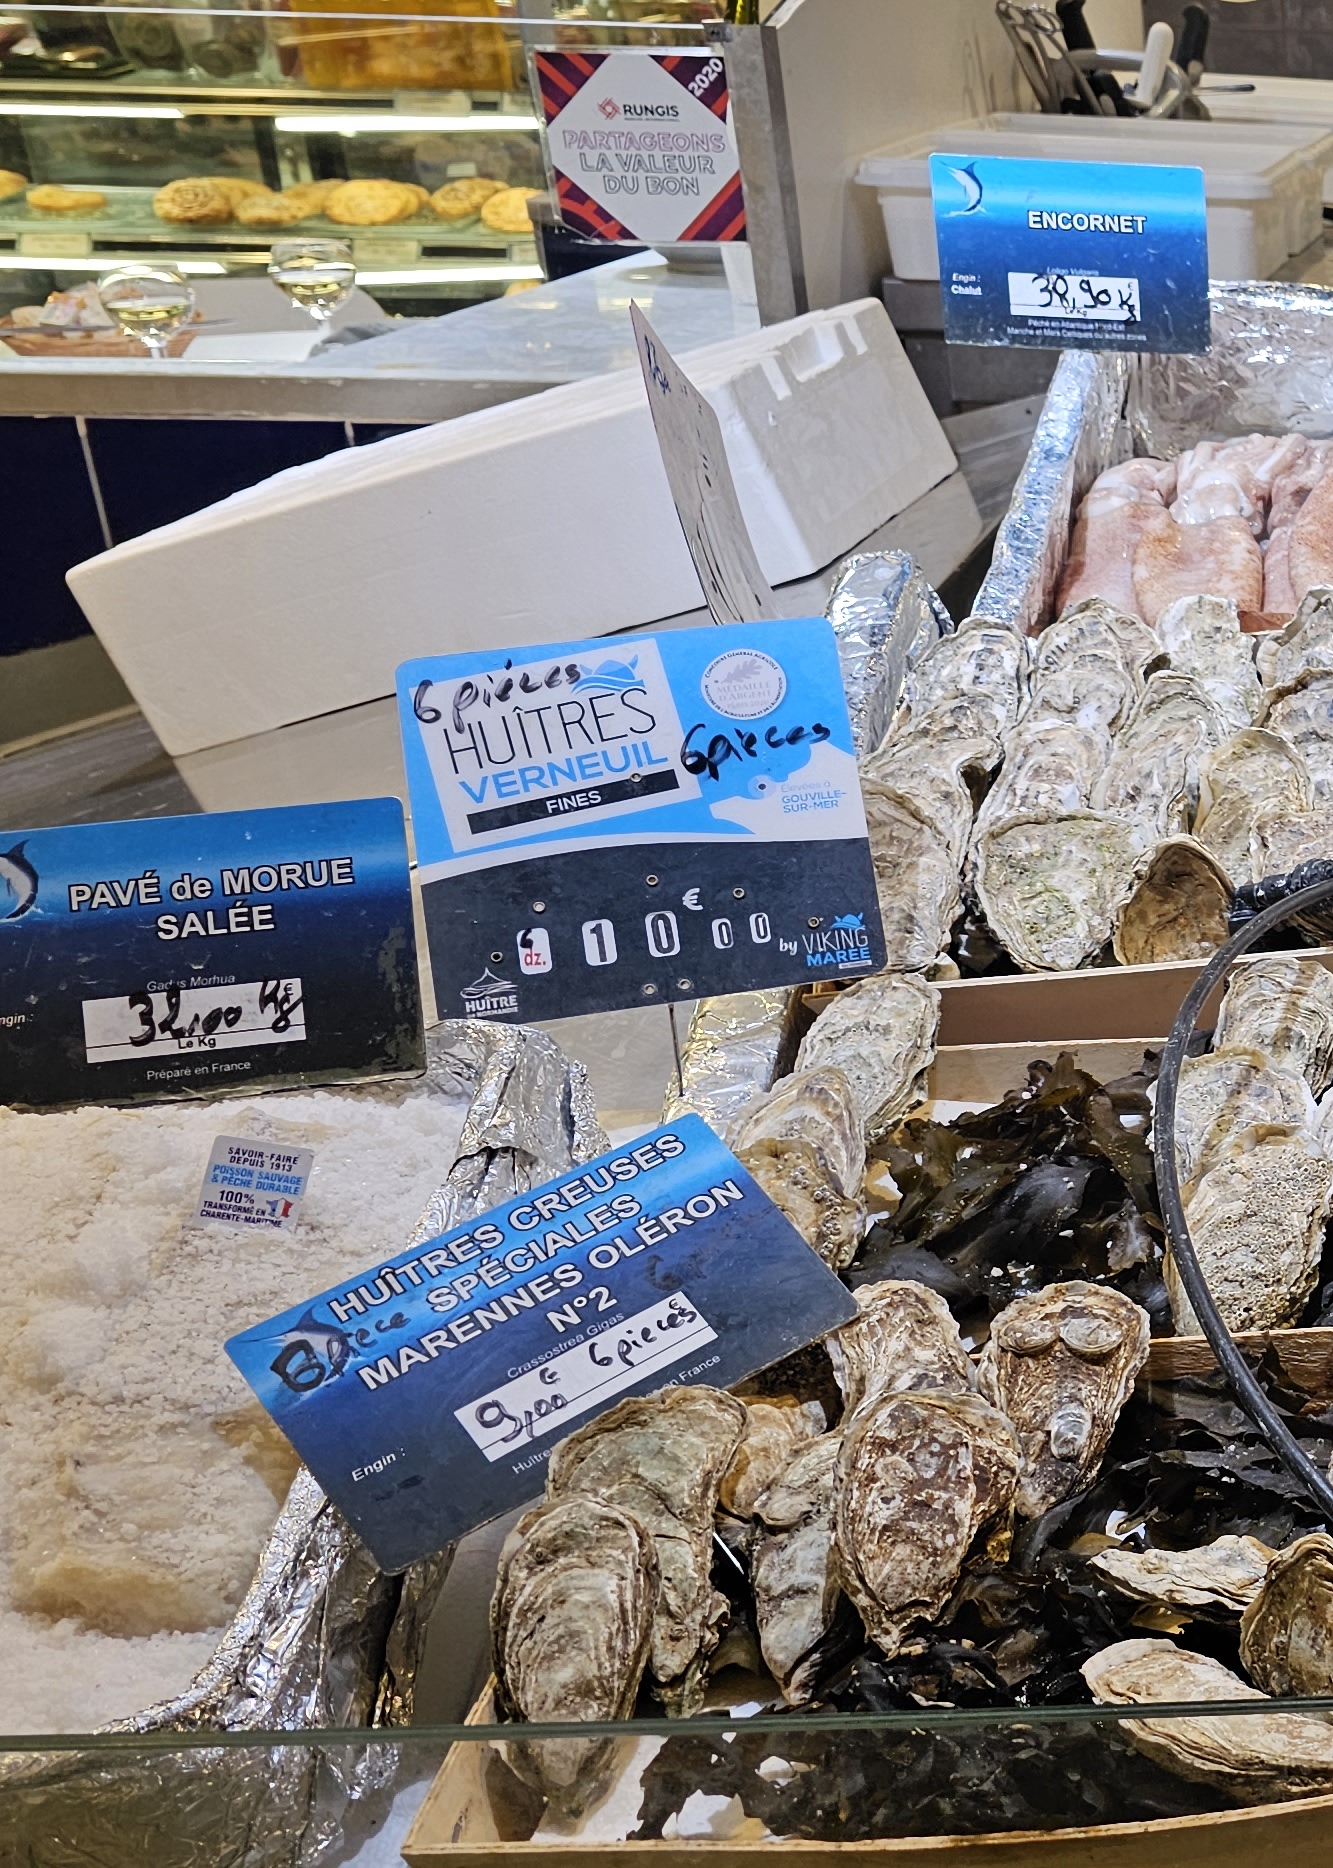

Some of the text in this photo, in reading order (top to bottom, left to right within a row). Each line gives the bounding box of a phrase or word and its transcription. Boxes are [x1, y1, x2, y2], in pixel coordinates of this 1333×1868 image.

[687, 57, 724, 98] 2020
[623, 103, 679, 118] RUNGIS
[562, 129, 726, 153] PARTAGEONS
[579, 152, 716, 174] LA VALEUR
[603, 175, 700, 196] DU BON
[1027, 209, 1147, 234] ENCORNET
[443, 686, 658, 775] HUÎTRES
[458, 740, 669, 805] VERNEUIL
[545, 789, 603, 815] FINES
[781, 789, 847, 804] GOUVILLE-
[783, 800, 839, 814] SUR-MER
[68, 857, 355, 912] PAVÉ de MORUE
[156, 901, 276, 941] SALÉE
[779, 938, 798, 956] by
[801, 926, 869, 953] VIKING
[805, 947, 871, 968] MAREE
[147, 972, 236, 993] Gadus Morhua
[464, 993, 518, 1013] HUÎTRE
[178, 1035, 217, 1050] Le Kg
[146, 1060, 251, 1081] Préparé en France
[228, 1146, 299, 1165] SAVOIR-FAIRE
[230, 1155, 293, 1172] DEPUIS 1913
[211, 1173, 300, 1195] & PÊCHE DURABLE
[257, 1171, 303, 1186] SAUVAGE
[203, 1200, 267, 1217] TRANSFORMÉ EN
[219, 1190, 255, 1205] 100%
[327, 1133, 687, 1324] HUÎTRES CREUSES
[425, 1191, 643, 1313] SPÉCIALES
[358, 1178, 746, 1394] MARENNES OLÉRON
[546, 1284, 619, 1335] N°2
[507, 1311, 625, 1380] Crassostrea Gigas
[679, 1354, 721, 1380] France
[351, 1450, 397, 1484] Engin
